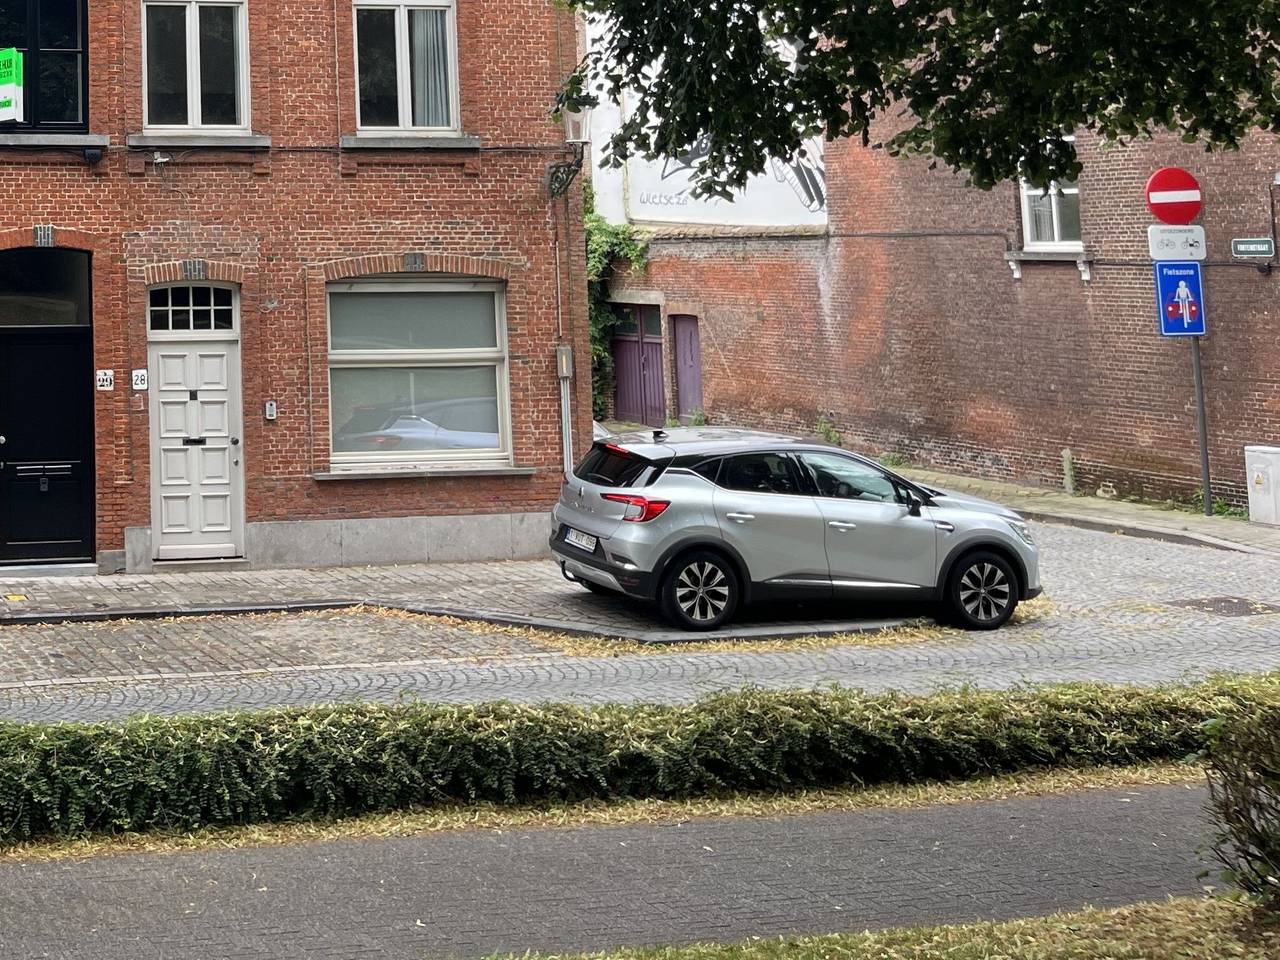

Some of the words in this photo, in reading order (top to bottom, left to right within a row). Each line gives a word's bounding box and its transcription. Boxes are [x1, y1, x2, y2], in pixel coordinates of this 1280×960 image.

[1163, 268, 1195, 276] Fietszone
[98, 377, 113, 387] 29
[134, 374, 146, 386] 28
